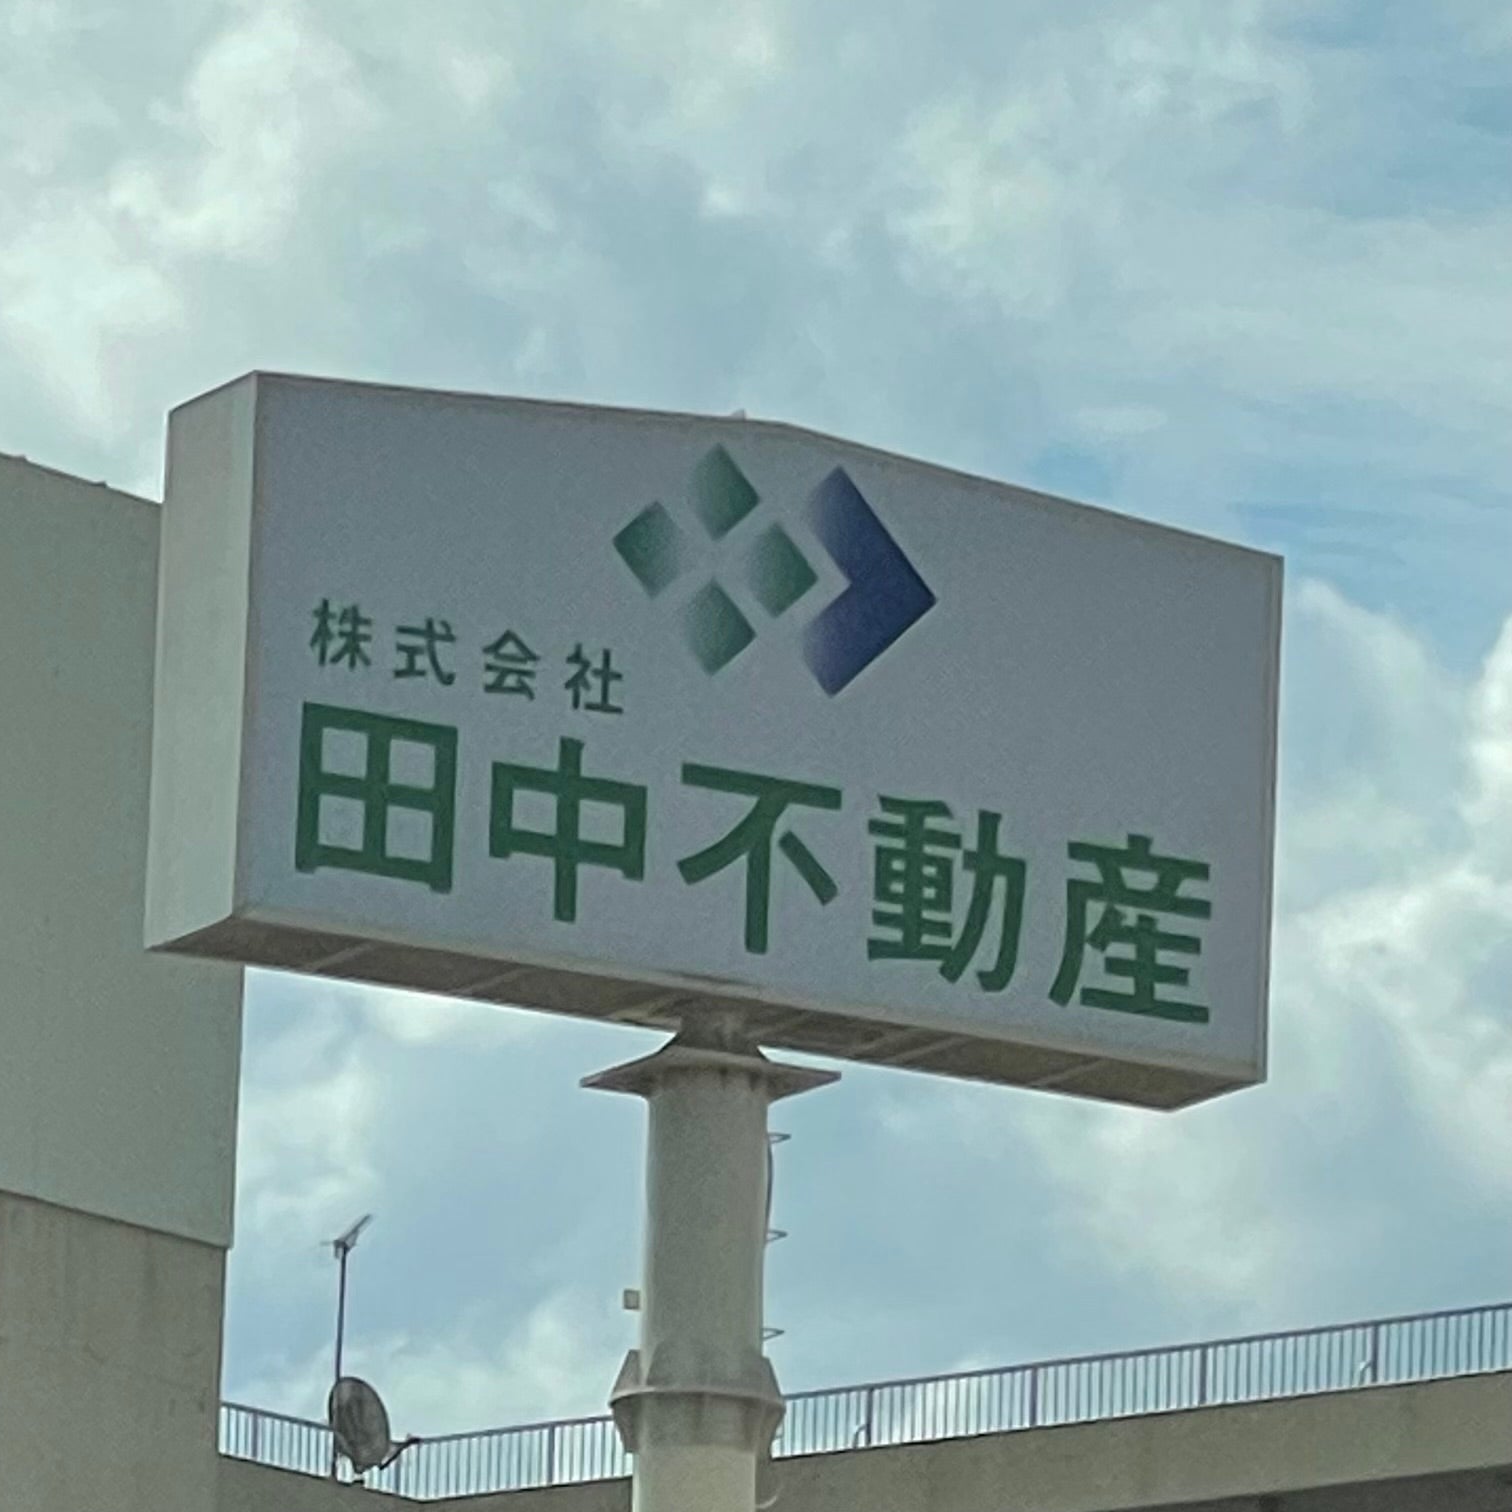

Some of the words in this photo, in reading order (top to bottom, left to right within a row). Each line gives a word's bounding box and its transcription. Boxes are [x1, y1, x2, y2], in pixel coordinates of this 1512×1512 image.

[308, 599, 625, 714] 株式会社
[295, 700, 1210, 1024] 田中不動産
